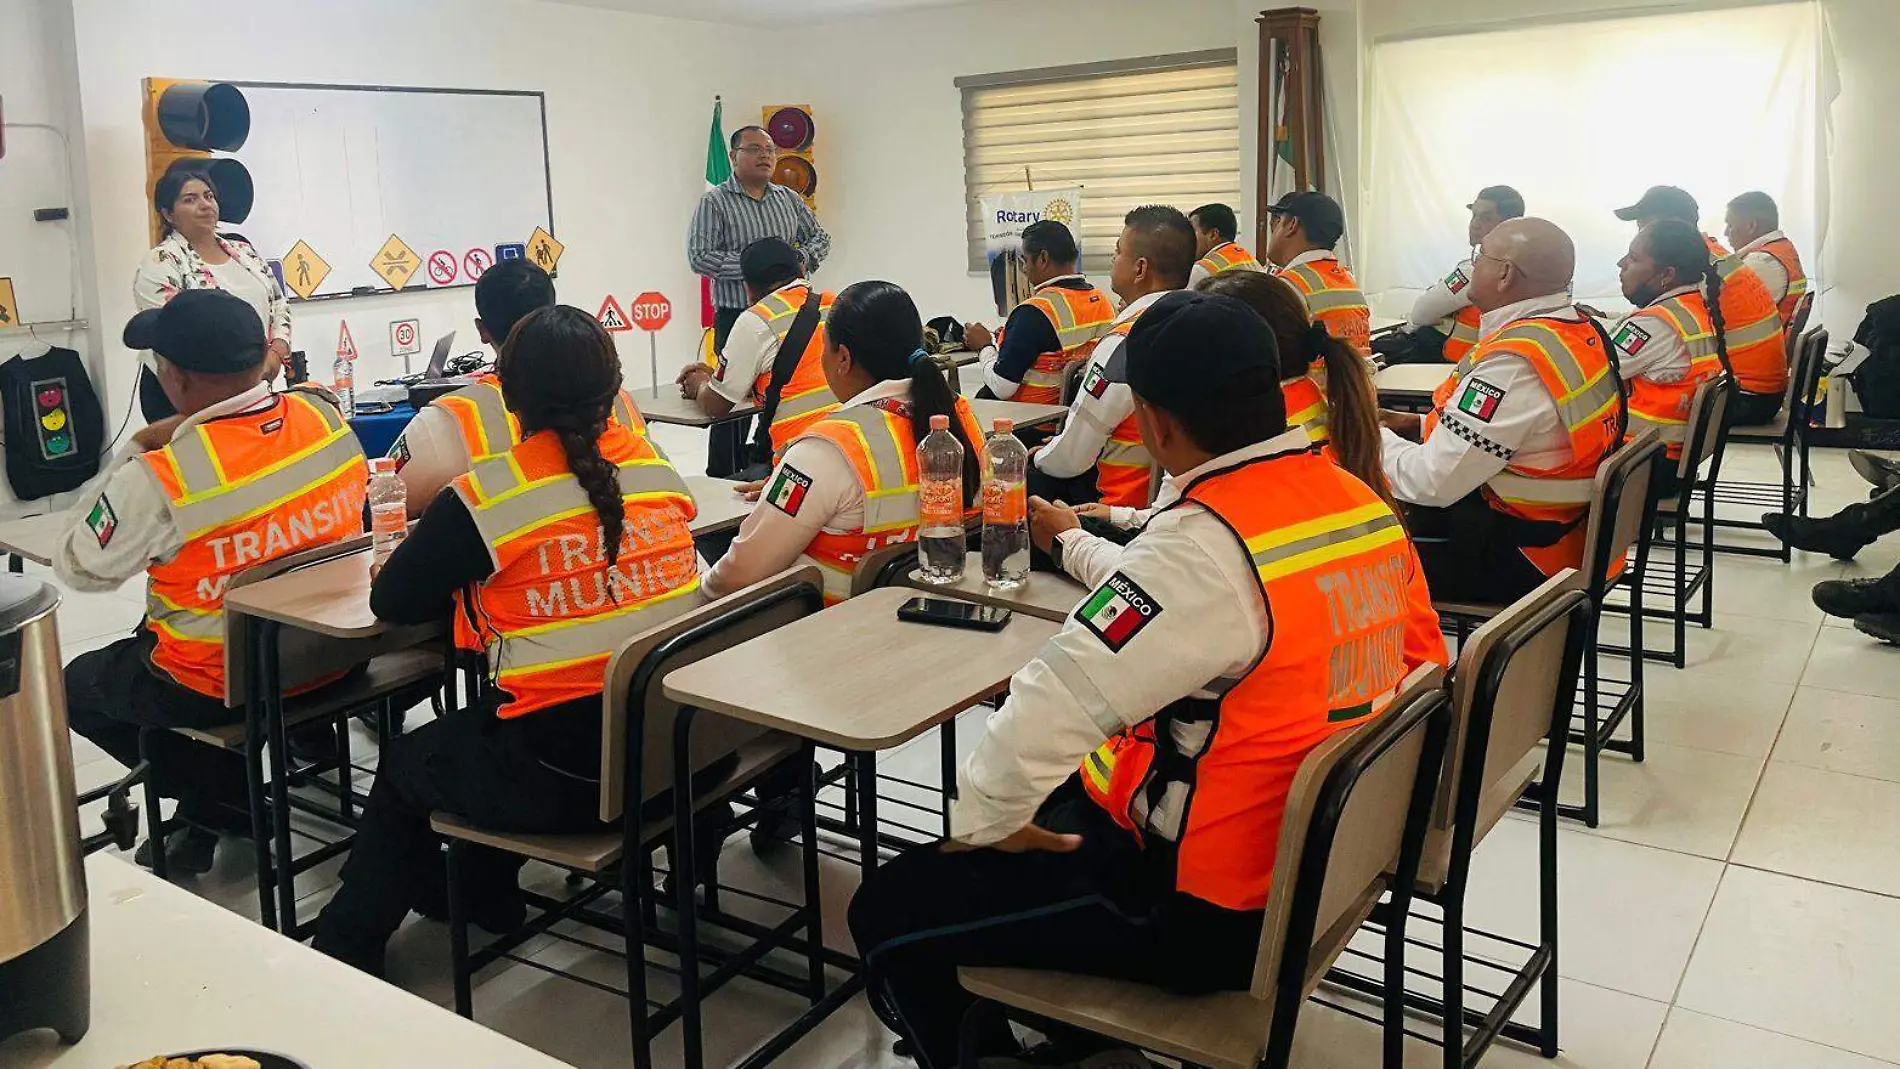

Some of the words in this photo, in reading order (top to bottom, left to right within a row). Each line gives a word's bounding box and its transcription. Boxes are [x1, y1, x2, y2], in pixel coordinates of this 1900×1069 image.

[996, 210, 1040, 224] Rotary
[634, 303, 669, 320] STOP
[400, 329, 411, 340] 30
[1108, 577, 1151, 616] MÉXICO
